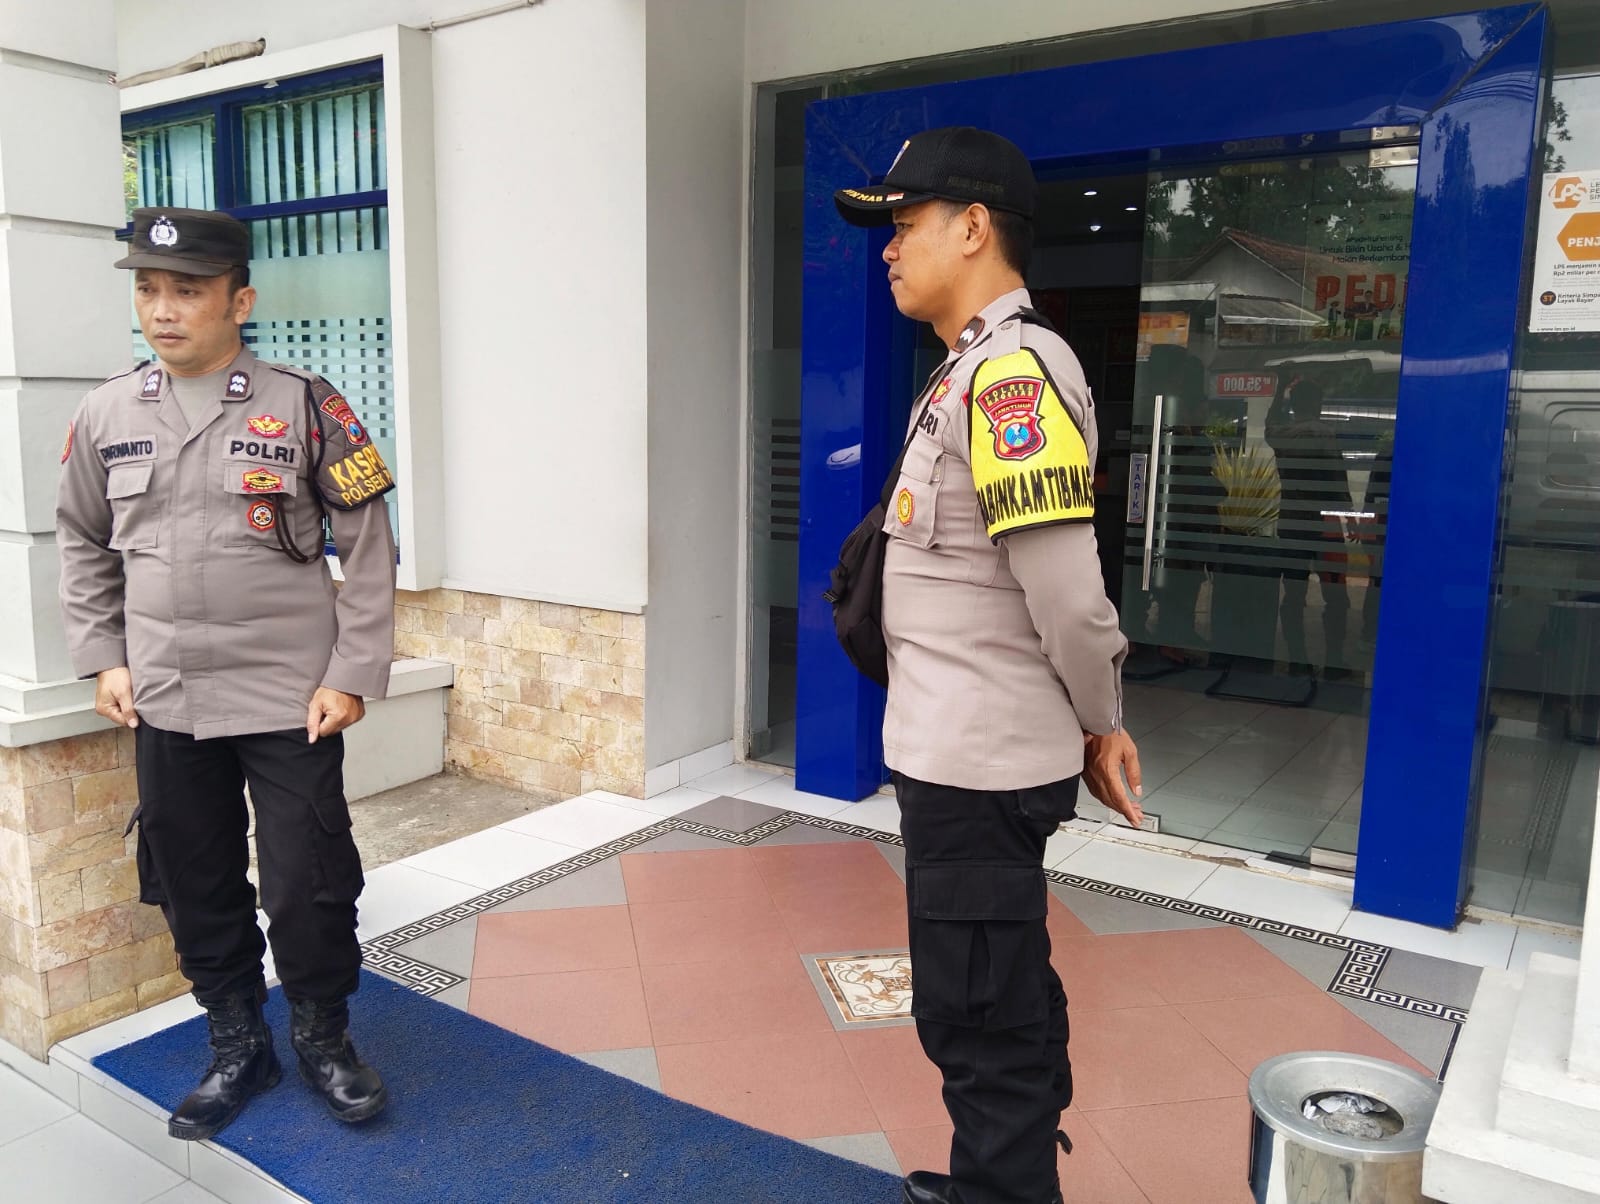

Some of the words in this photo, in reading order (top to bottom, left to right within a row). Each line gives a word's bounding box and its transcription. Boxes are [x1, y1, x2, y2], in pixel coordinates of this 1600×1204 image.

[1549, 181, 1588, 205] LPS
[1314, 274, 1408, 312] PED
[984, 383, 1034, 401] POLRES
[230, 440, 295, 463] POLRI
[1132, 463, 1142, 509] TARIK
